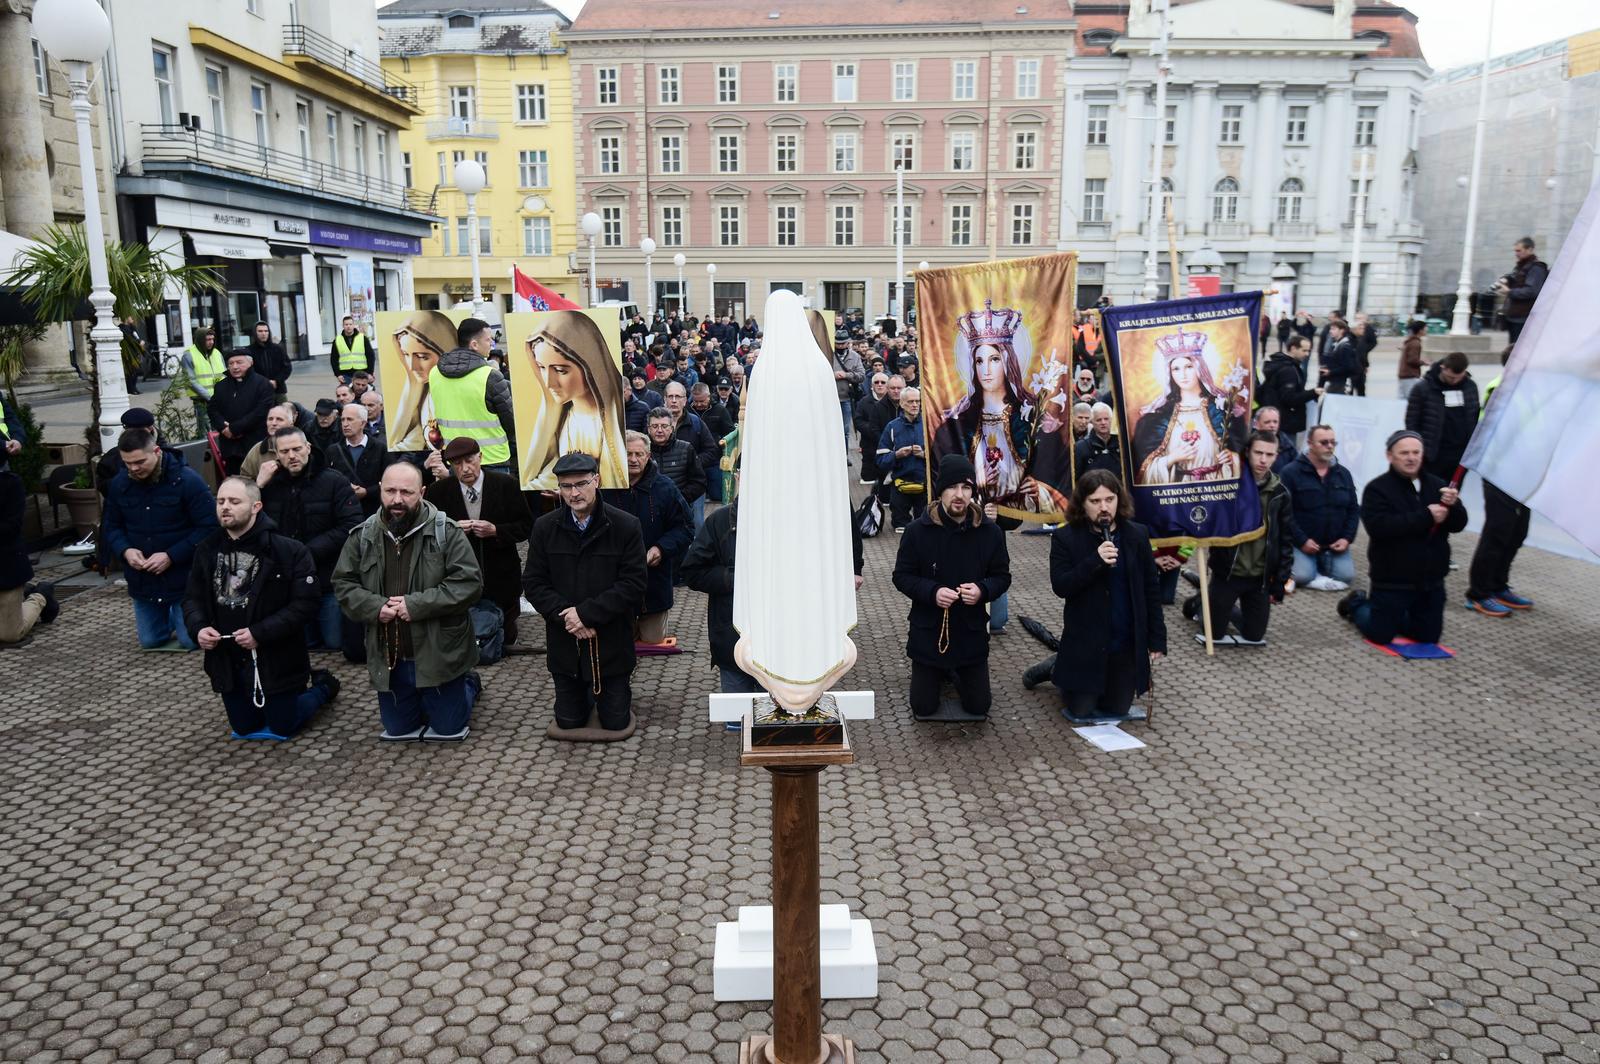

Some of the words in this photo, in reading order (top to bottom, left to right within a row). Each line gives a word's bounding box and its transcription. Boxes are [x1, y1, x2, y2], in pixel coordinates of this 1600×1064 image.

[224, 248, 247, 257] CHANEL
[1119, 317, 1156, 328] KRALJICE
[1194, 310, 1216, 320] MOLI
[1216, 308, 1228, 317] ZA
[1152, 487, 1183, 497] SLATKO
[1183, 486, 1203, 495] SRCE
[1203, 483, 1239, 493] MARIJINO
[1159, 497, 1179, 505] BUDI
[1179, 494, 1200, 504] NAŠE
[1200, 492, 1237, 502] SPASENJE
